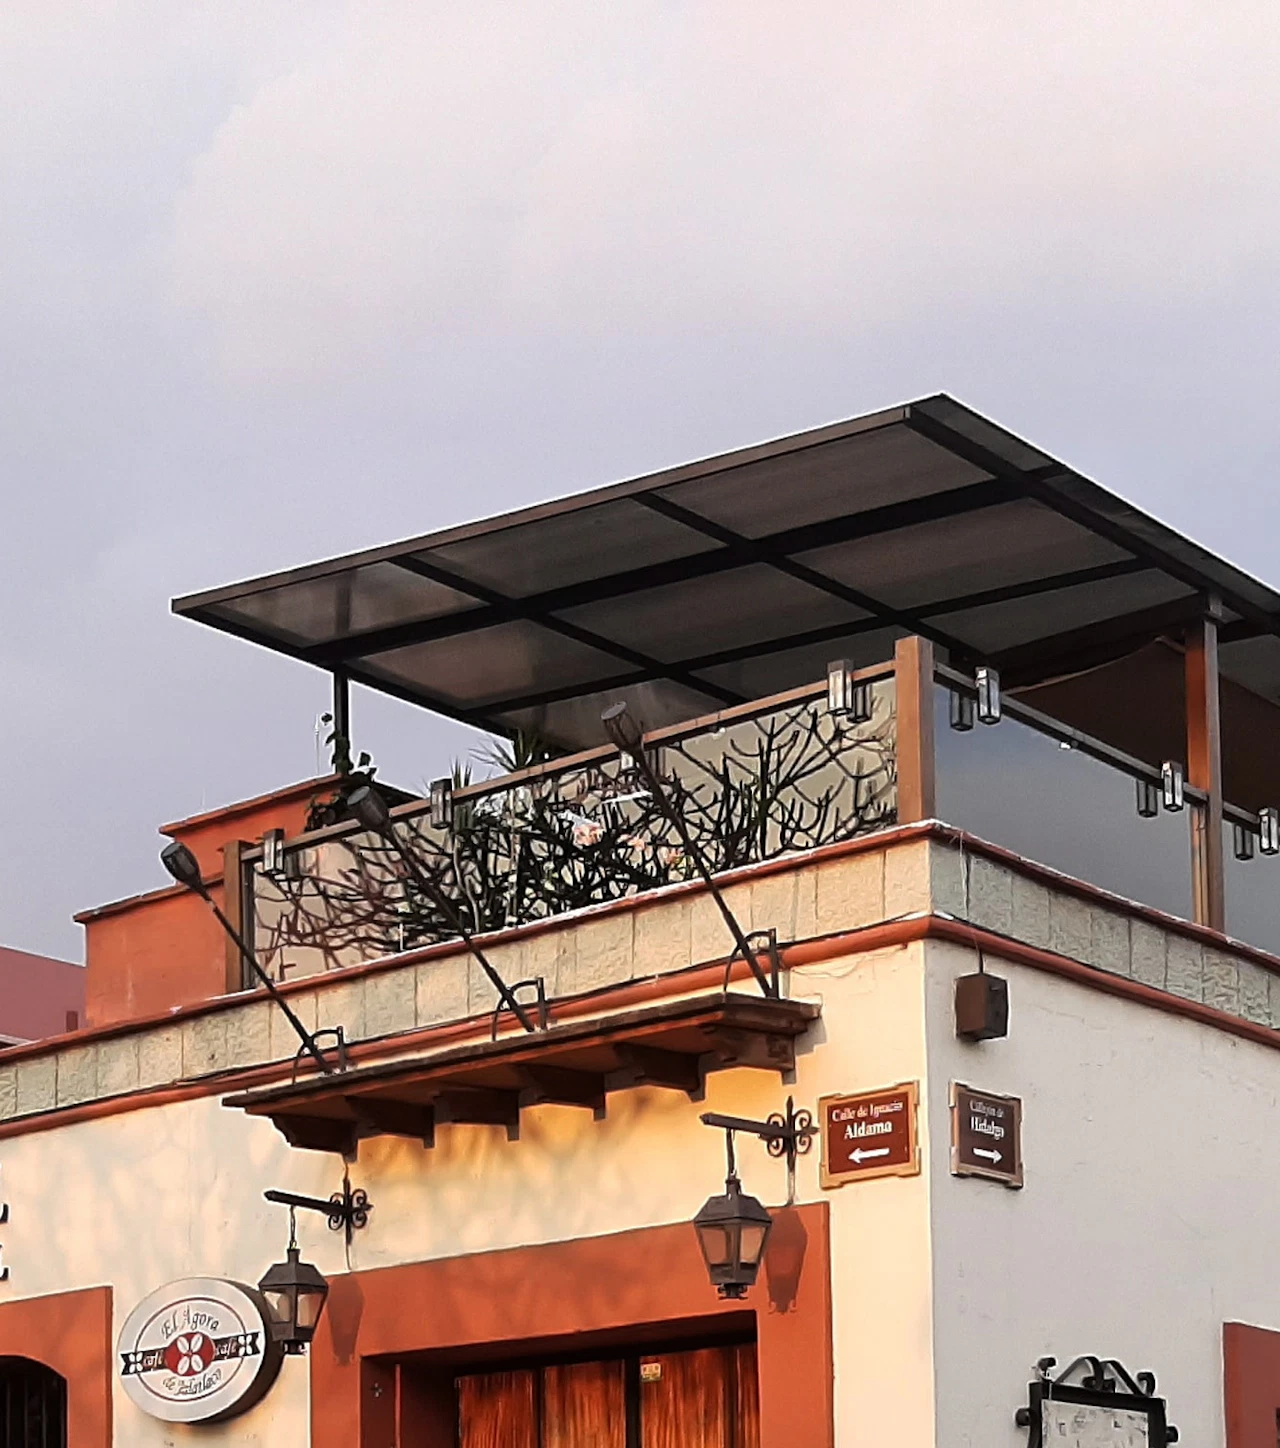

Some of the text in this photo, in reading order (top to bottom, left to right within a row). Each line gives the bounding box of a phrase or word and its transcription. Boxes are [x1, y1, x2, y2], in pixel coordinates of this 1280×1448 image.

[832, 1107, 856, 1121] Calle
[857, 1105, 868, 1118] de
[843, 1121, 893, 1140] Aldama
[970, 1116, 1005, 1140] Hidalgo
[161, 1309, 177, 1340] El
